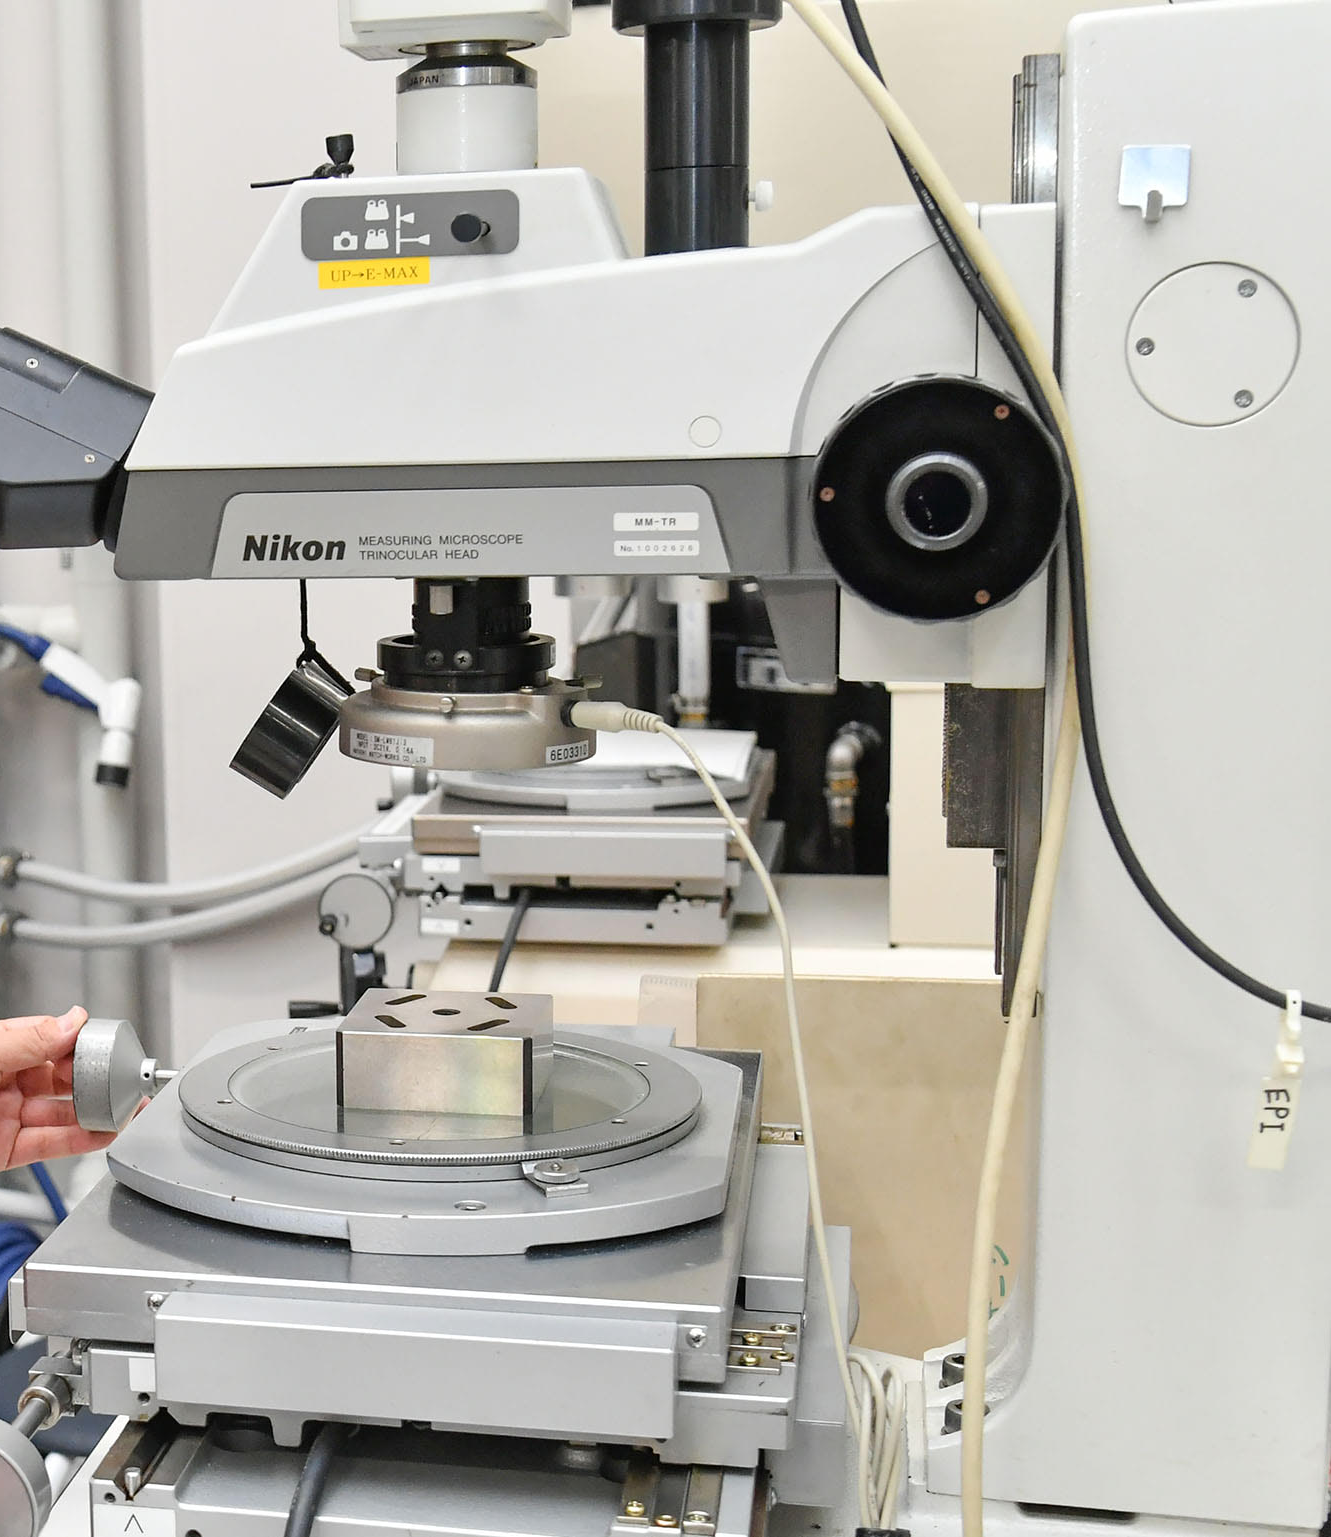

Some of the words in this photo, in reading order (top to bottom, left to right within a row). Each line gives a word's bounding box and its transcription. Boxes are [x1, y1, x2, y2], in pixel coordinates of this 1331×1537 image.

[409, 75, 439, 86] JAPAN
[634, 517, 677, 527] MM-TR
[243, 534, 346, 561] Nikon
[358, 535, 432, 546] MEASURING
[439, 534, 523, 545] MICROSCOPE
[359, 549, 438, 561] TRINOCULAR
[445, 549, 479, 560] HEAD
[1260, 1089, 1290, 1133] EPI
